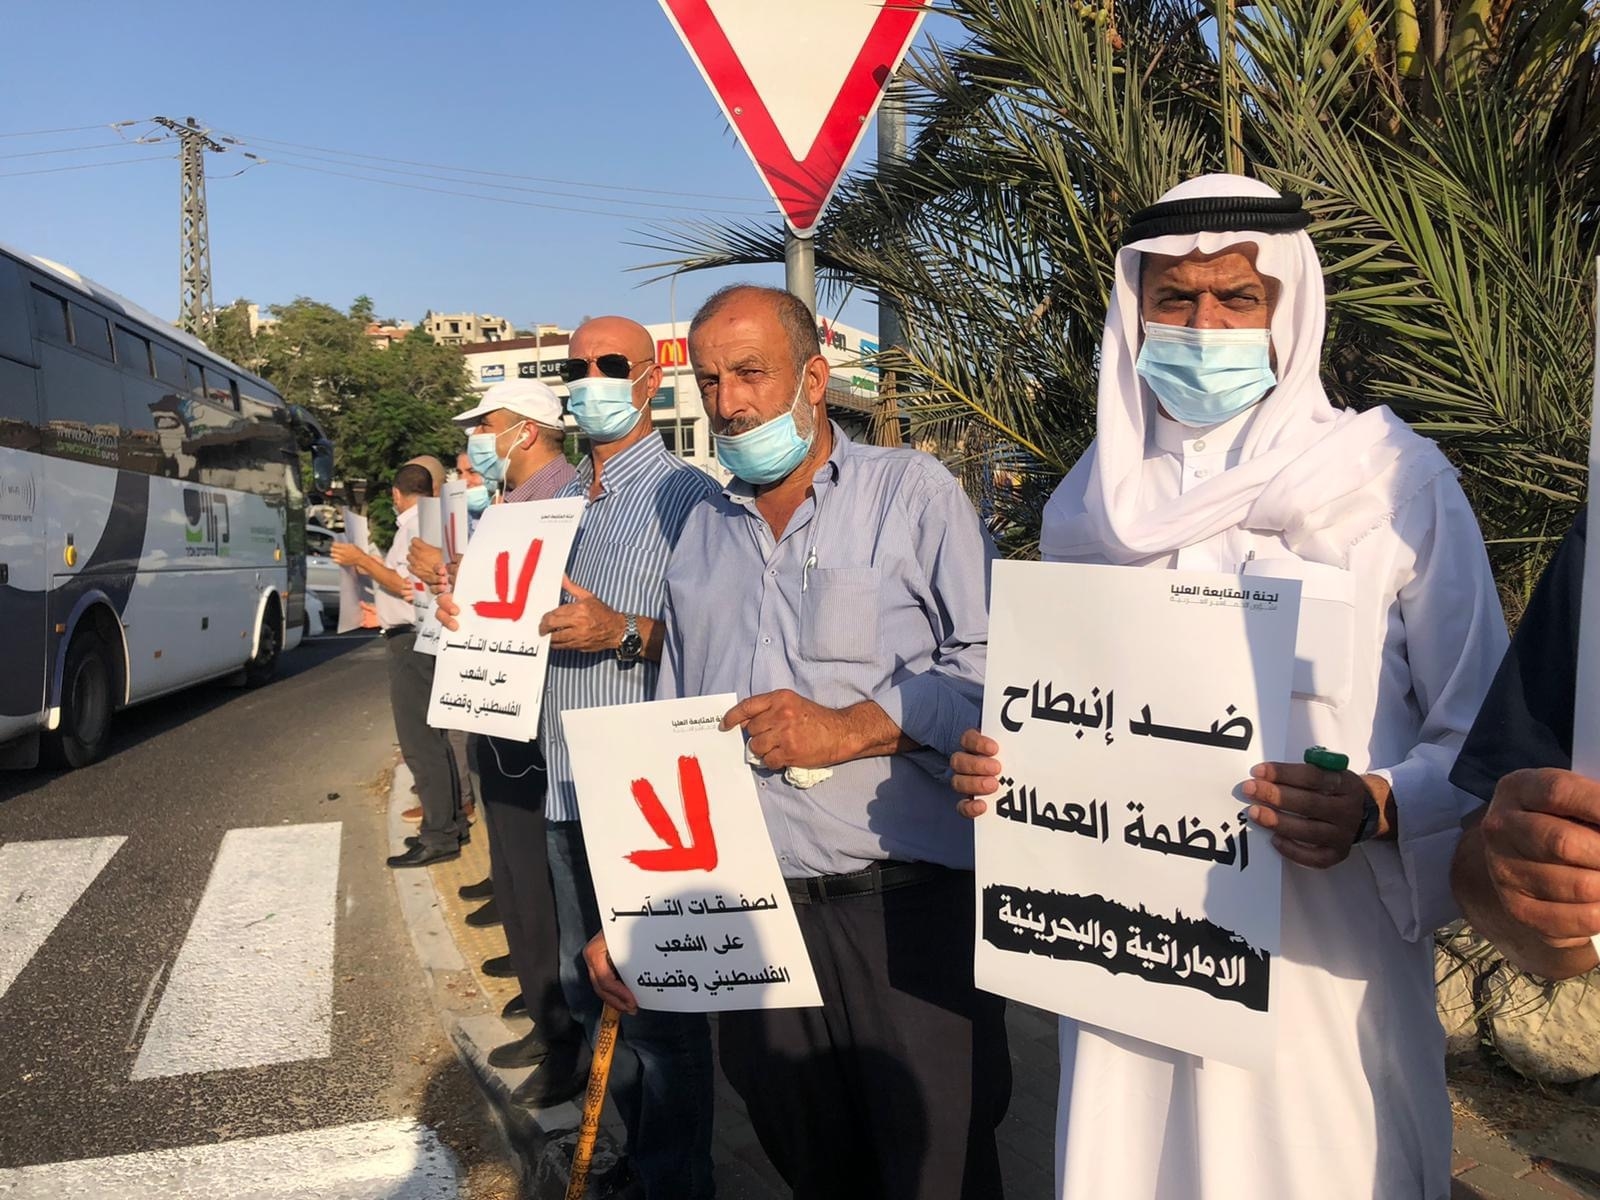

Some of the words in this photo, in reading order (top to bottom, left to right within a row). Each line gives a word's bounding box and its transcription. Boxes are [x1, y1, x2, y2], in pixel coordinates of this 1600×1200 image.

[471, 537, 543, 621] لا
[1171, 584, 1200, 596] العليا
[1202, 587, 1250, 600] المتابعة
[1252, 590, 1279, 604] لجنة
[459, 666, 488, 682] الشعب
[489, 670, 508, 686] على
[439, 692, 472, 713] وقضيته
[473, 698, 521, 719] الفلسطيني
[1000, 679, 1114, 746] إنبطاح
[1129, 704, 1253, 751] ضد
[622, 752, 718, 872] لا
[996, 775, 1109, 844] العمالة
[1124, 800, 1249, 872] أنظمة
[688, 893, 778, 915] لصفقات
[999, 894, 1118, 959] والبحرينية
[655, 933, 707, 957] الشعب
[713, 934, 744, 955] على
[1126, 925, 1246, 987] الاماراتية
[637, 969, 699, 993] وقضيته
[704, 965, 790, 995] الفلسطيني
